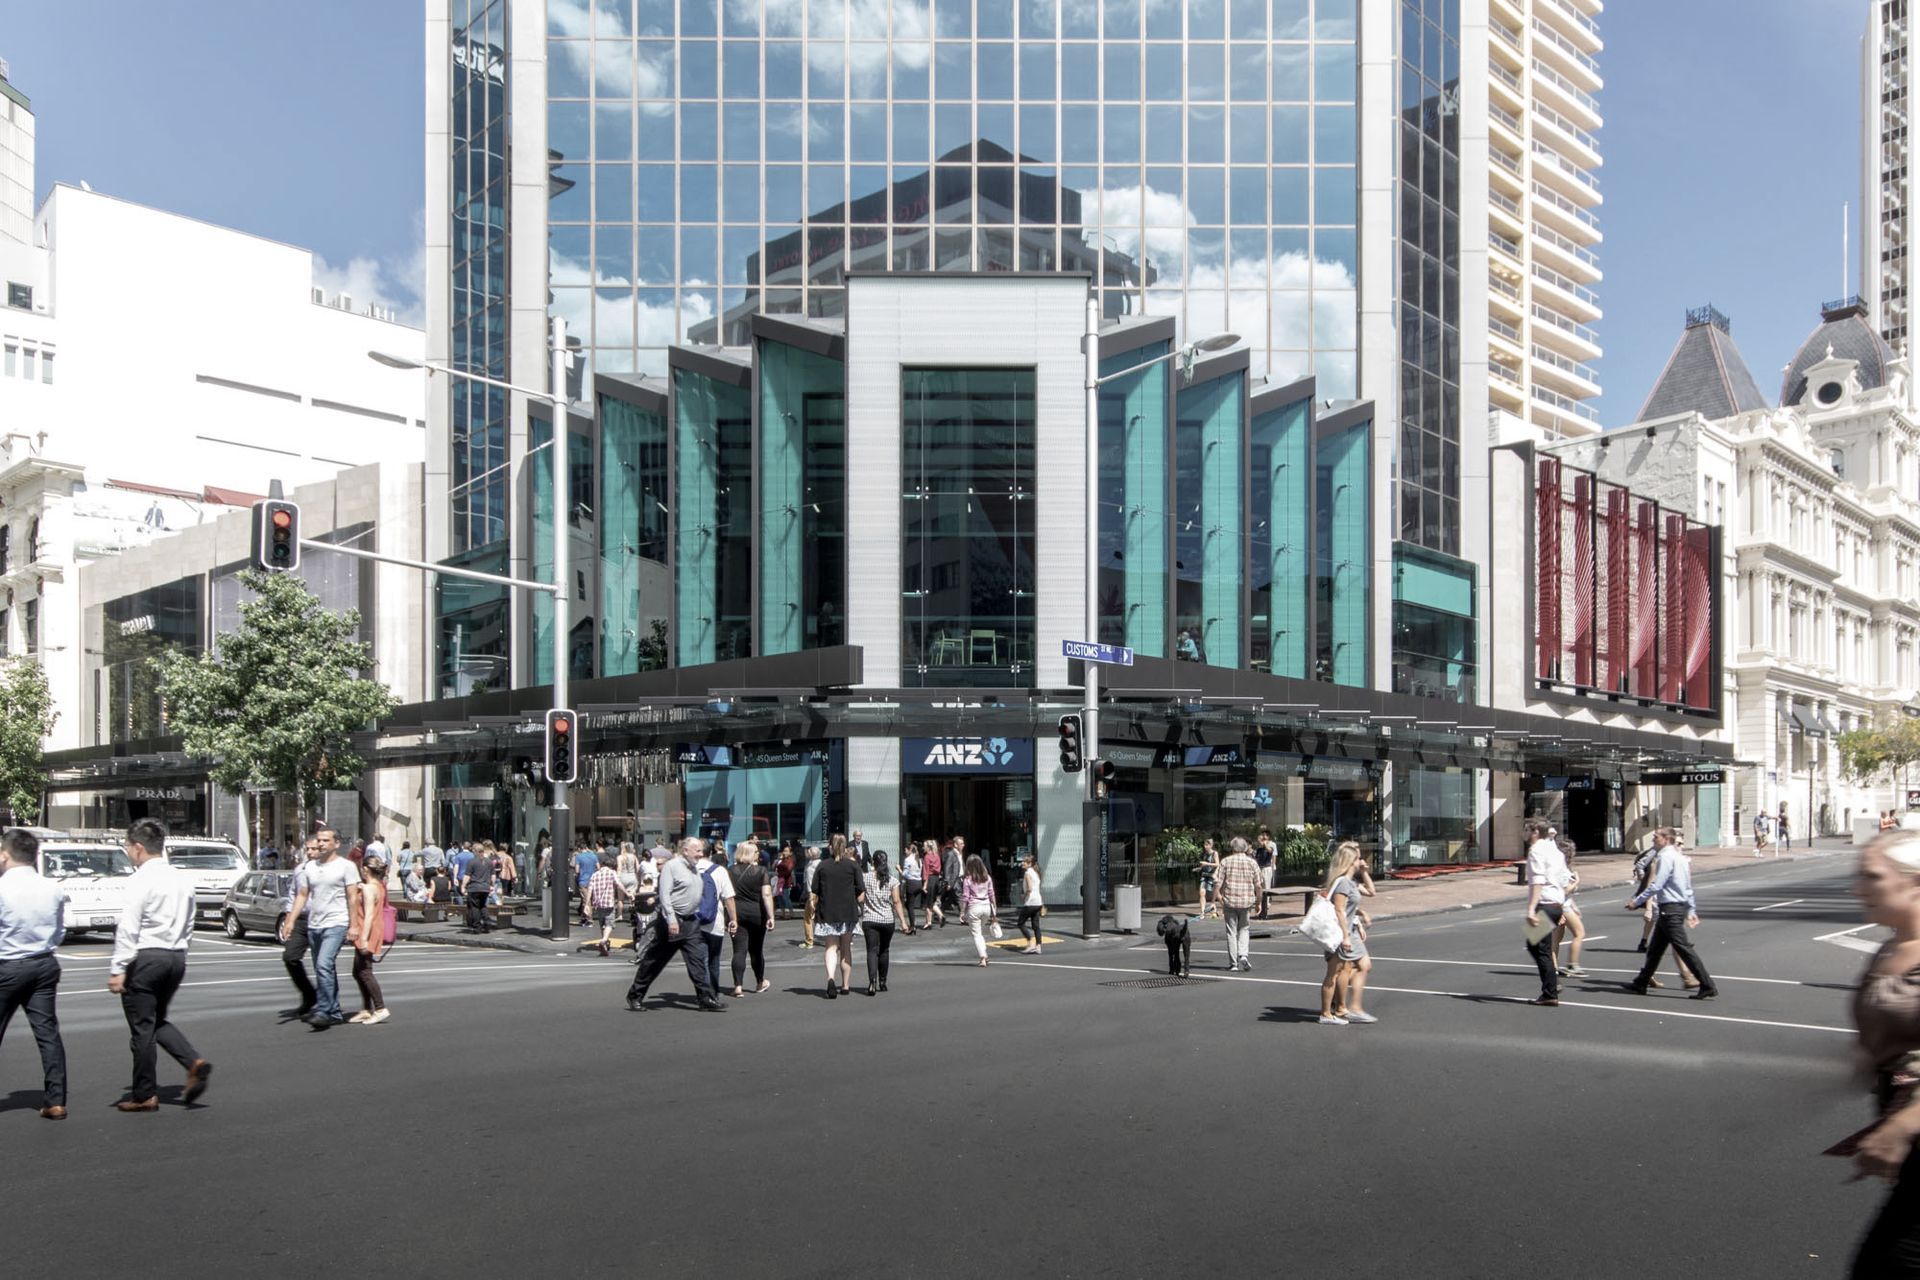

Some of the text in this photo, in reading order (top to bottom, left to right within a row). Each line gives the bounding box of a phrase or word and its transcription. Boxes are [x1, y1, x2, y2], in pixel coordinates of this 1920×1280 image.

[1066, 642, 1098, 658] CUSTOMS
[679, 752, 697, 762] ANZ
[764, 753, 782, 763] Queen
[783, 752, 799, 761] Street
[923, 744, 982, 765] ANZ
[1108, 750, 1116, 759] 45
[1116, 751, 1135, 761] Queen
[1135, 752, 1152, 761] Street
[1212, 754, 1228, 762] ANZ
[1690, 773, 1720, 782] TOUS
